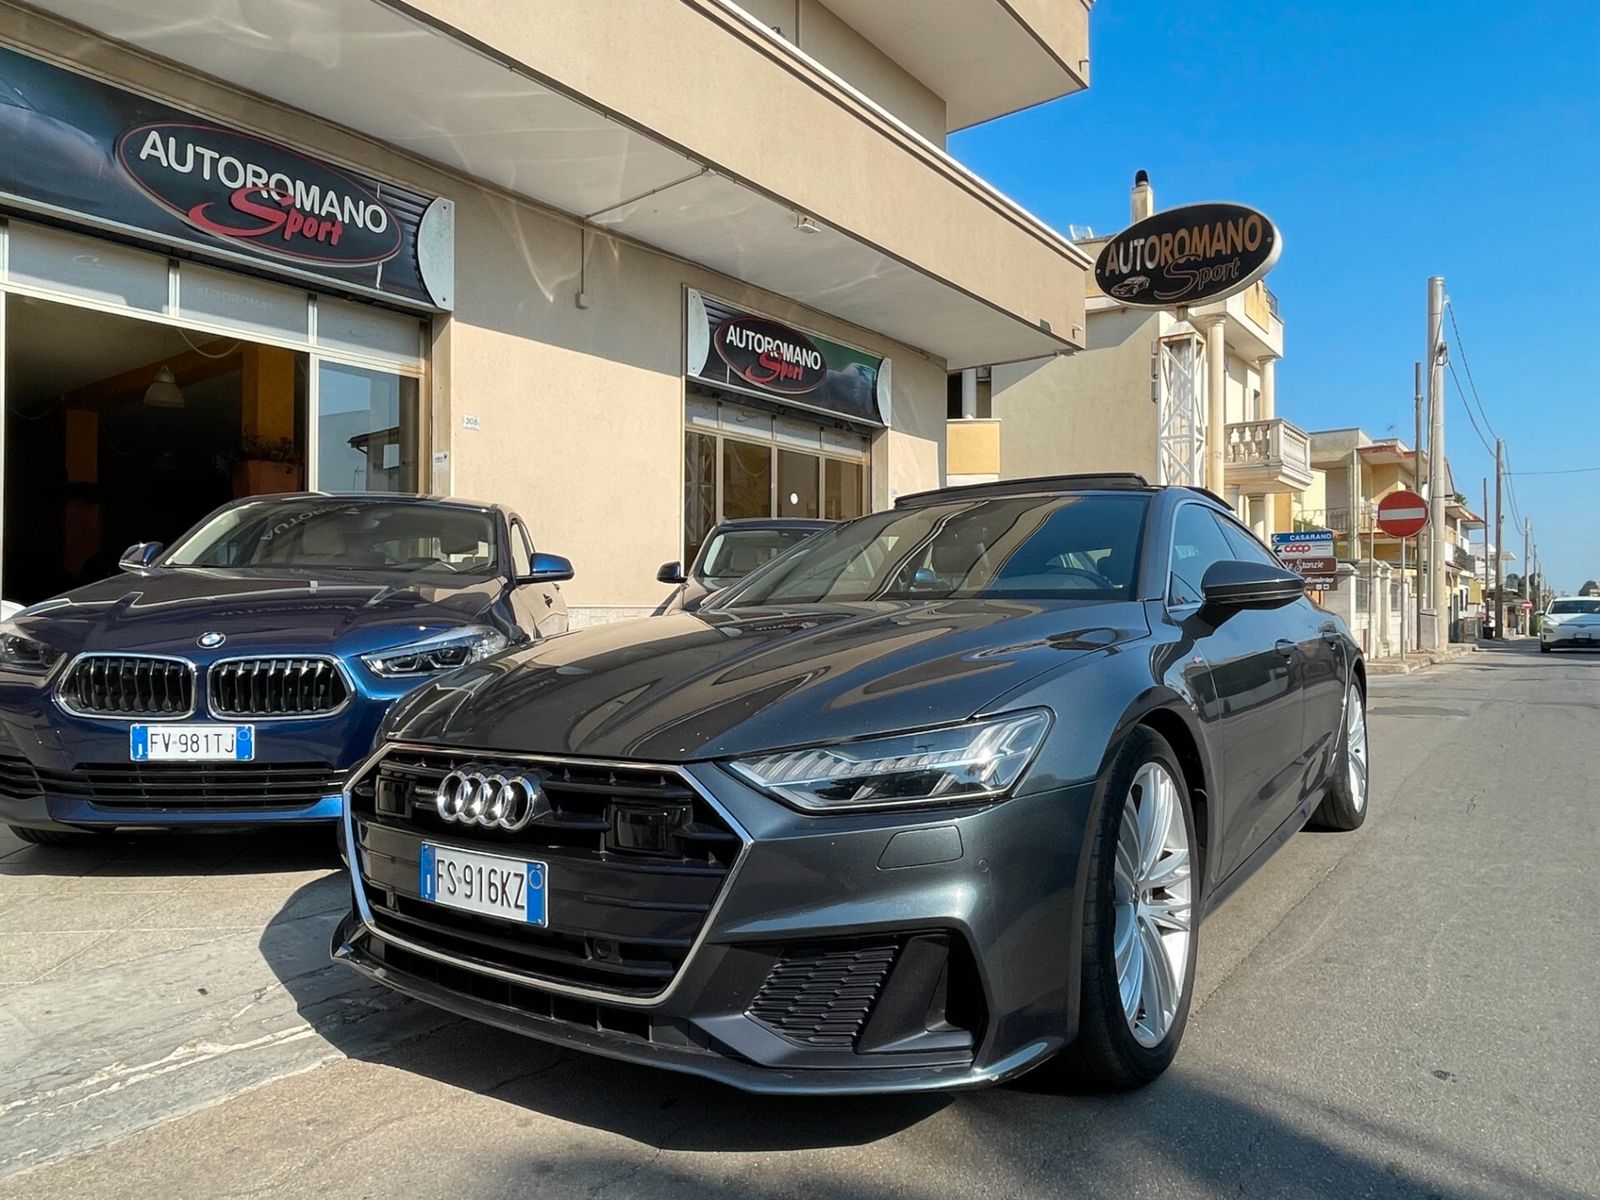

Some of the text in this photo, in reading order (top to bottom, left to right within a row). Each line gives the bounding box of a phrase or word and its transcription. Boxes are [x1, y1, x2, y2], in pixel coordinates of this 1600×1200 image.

[139, 130, 388, 234] AUTOROMANO
[187, 186, 343, 246] Sport
[1105, 214, 1263, 277] AUTOROMANO
[1153, 253, 1241, 300] Sport
[726, 324, 821, 370] AUTOROMANO
[745, 351, 804, 384] Sport
